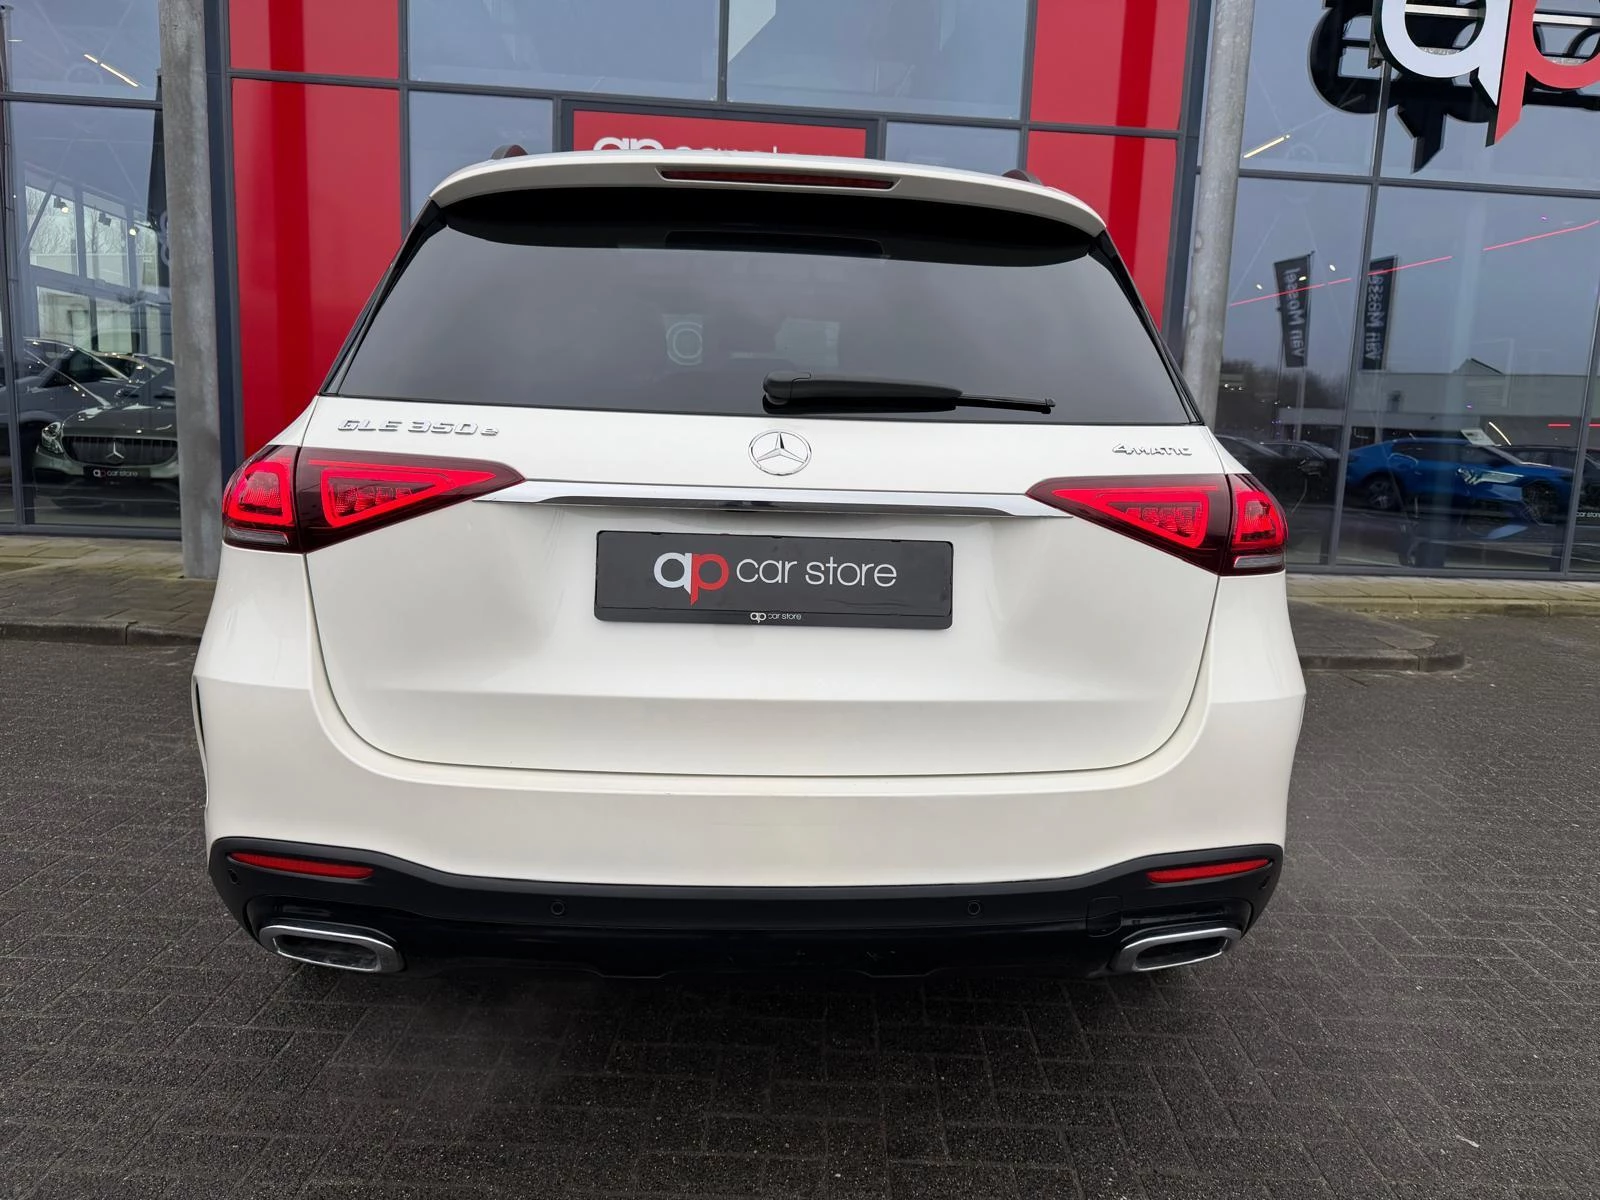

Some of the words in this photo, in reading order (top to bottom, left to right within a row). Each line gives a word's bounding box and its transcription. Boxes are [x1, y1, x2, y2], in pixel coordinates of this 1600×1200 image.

[338, 419, 402, 432] GLE
[653, 551, 730, 607] ap
[735, 557, 798, 585] car
[805, 556, 898, 588] store
[781, 612, 802, 621] store
